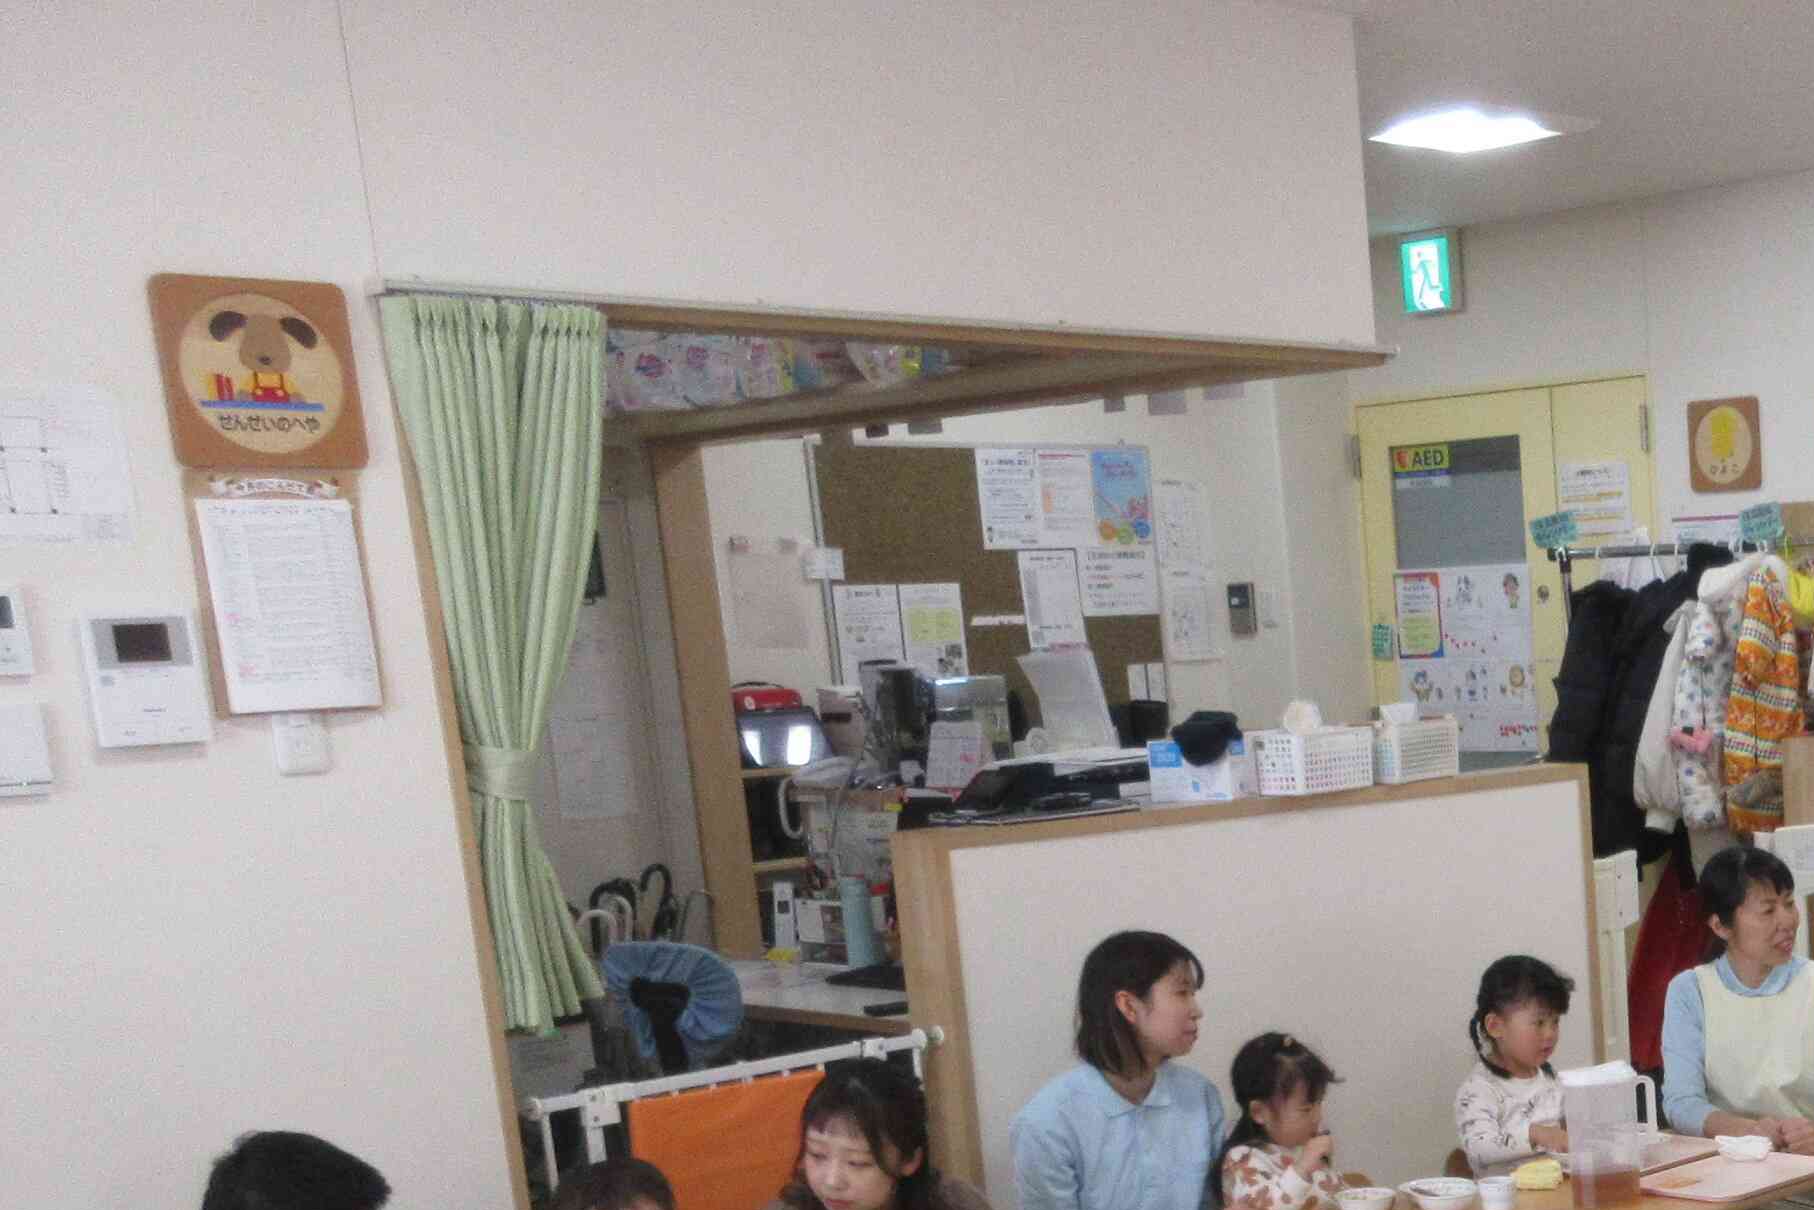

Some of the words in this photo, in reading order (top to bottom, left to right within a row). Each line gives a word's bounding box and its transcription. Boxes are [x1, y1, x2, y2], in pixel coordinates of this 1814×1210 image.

[218, 414, 321, 433] せんせいのへや
[1411, 449, 1445, 468] AED
